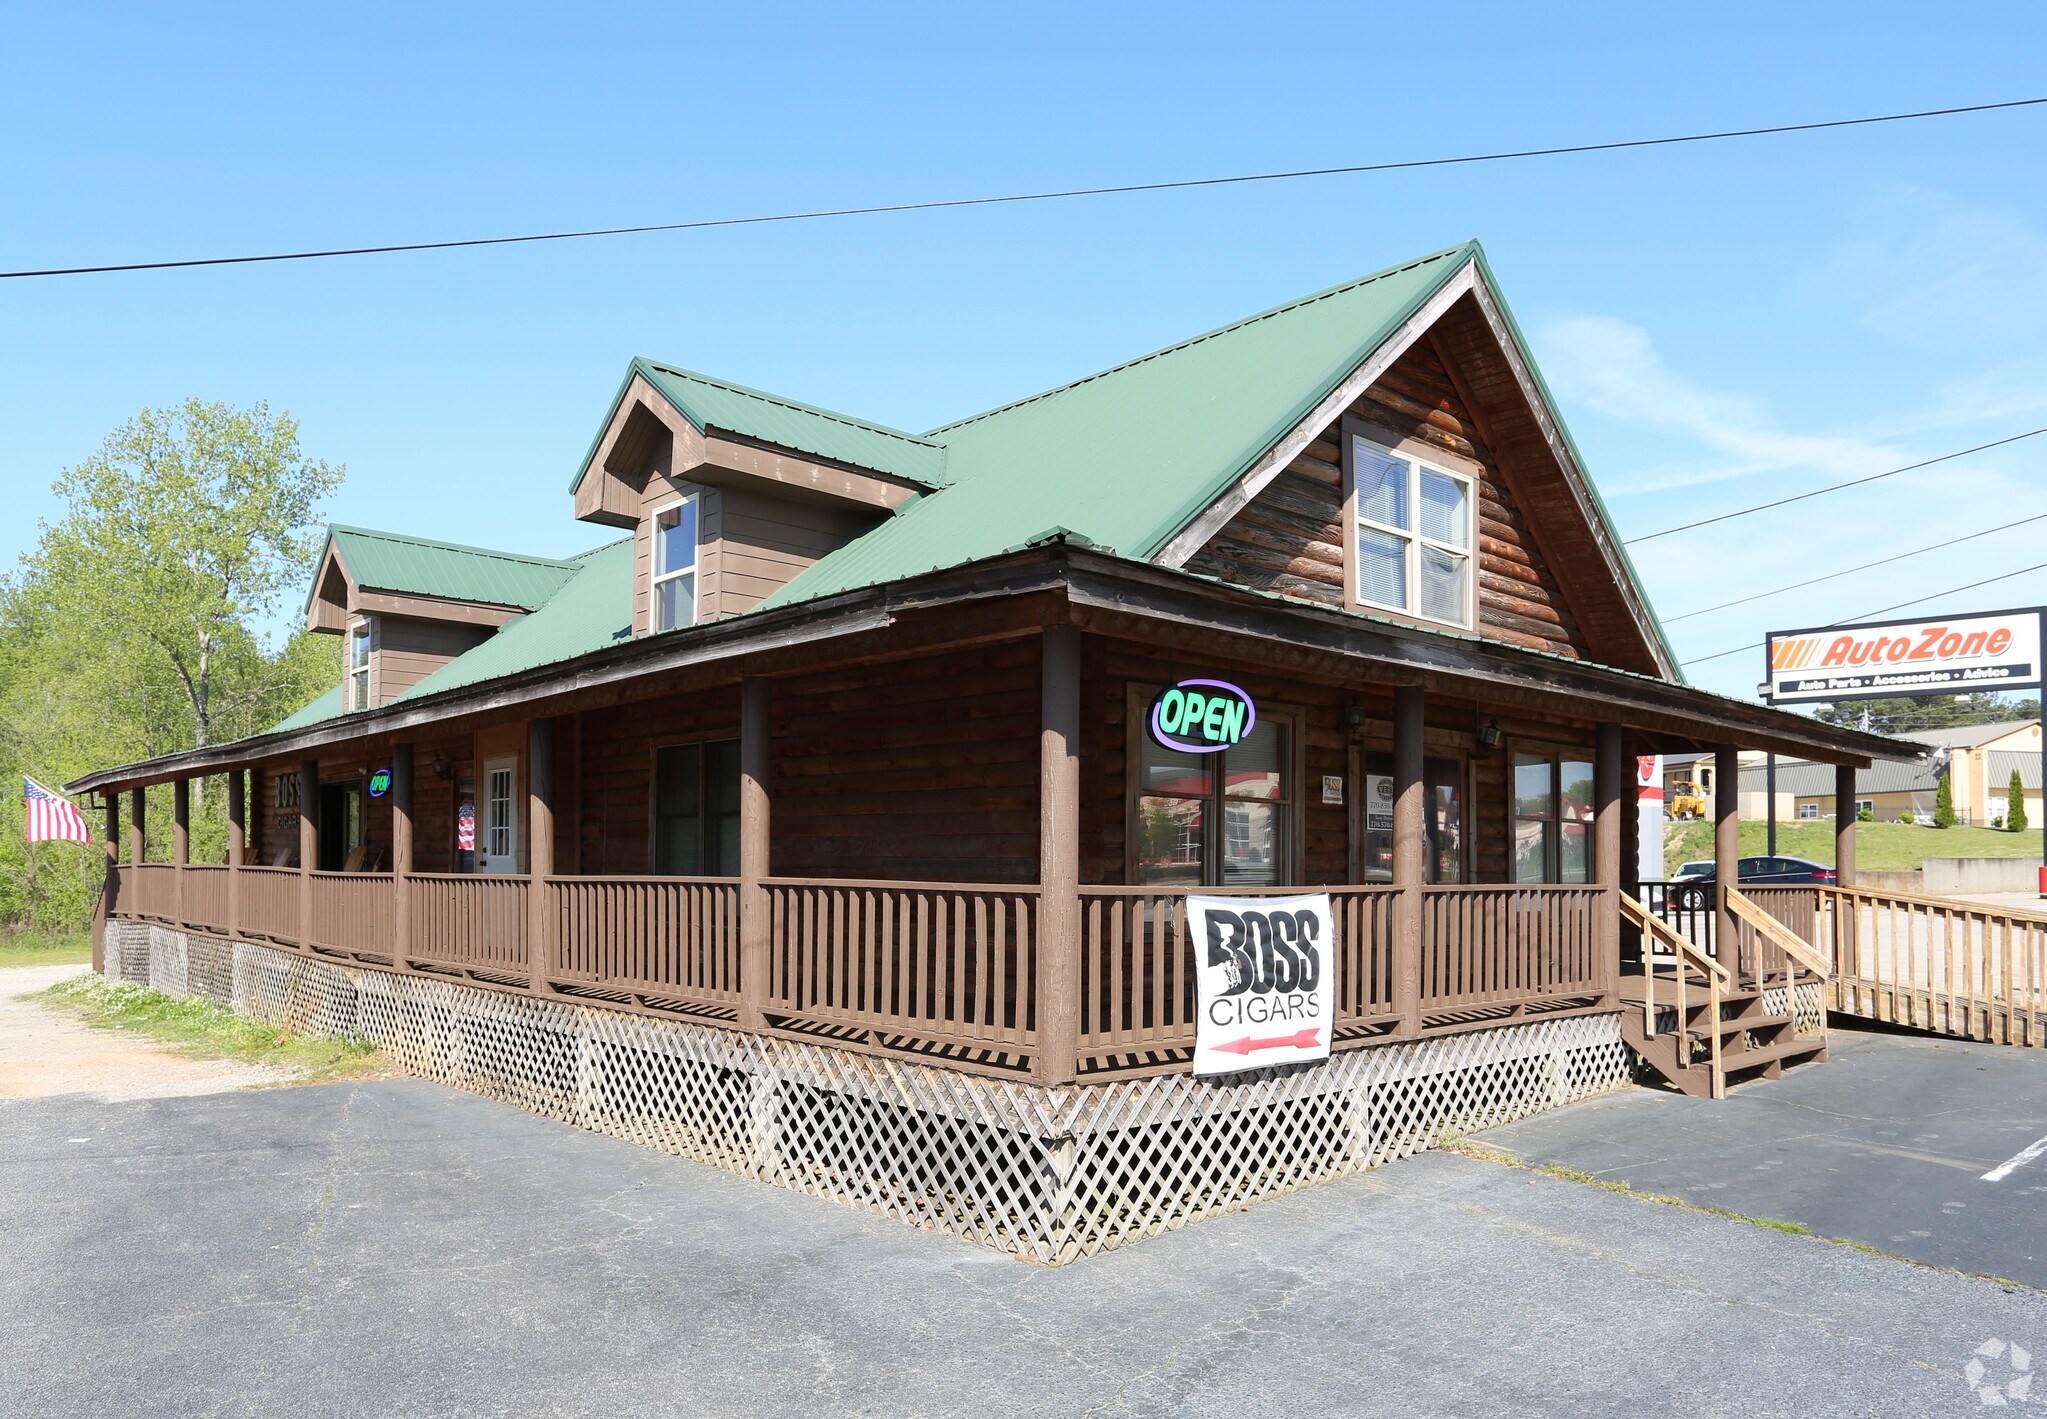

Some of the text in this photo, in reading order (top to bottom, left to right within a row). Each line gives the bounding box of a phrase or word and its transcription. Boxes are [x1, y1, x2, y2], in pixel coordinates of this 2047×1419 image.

[1820, 627, 2012, 667] AutoZone
[1798, 667, 2009, 691] Auto Parts Accessories Advice
[1159, 688, 1246, 744] OPEN
[275, 773, 301, 808] BOSS
[371, 775, 389, 791] OPEN
[1205, 909, 1320, 997] BOSS
[1209, 992, 1320, 1026] CIGARS
